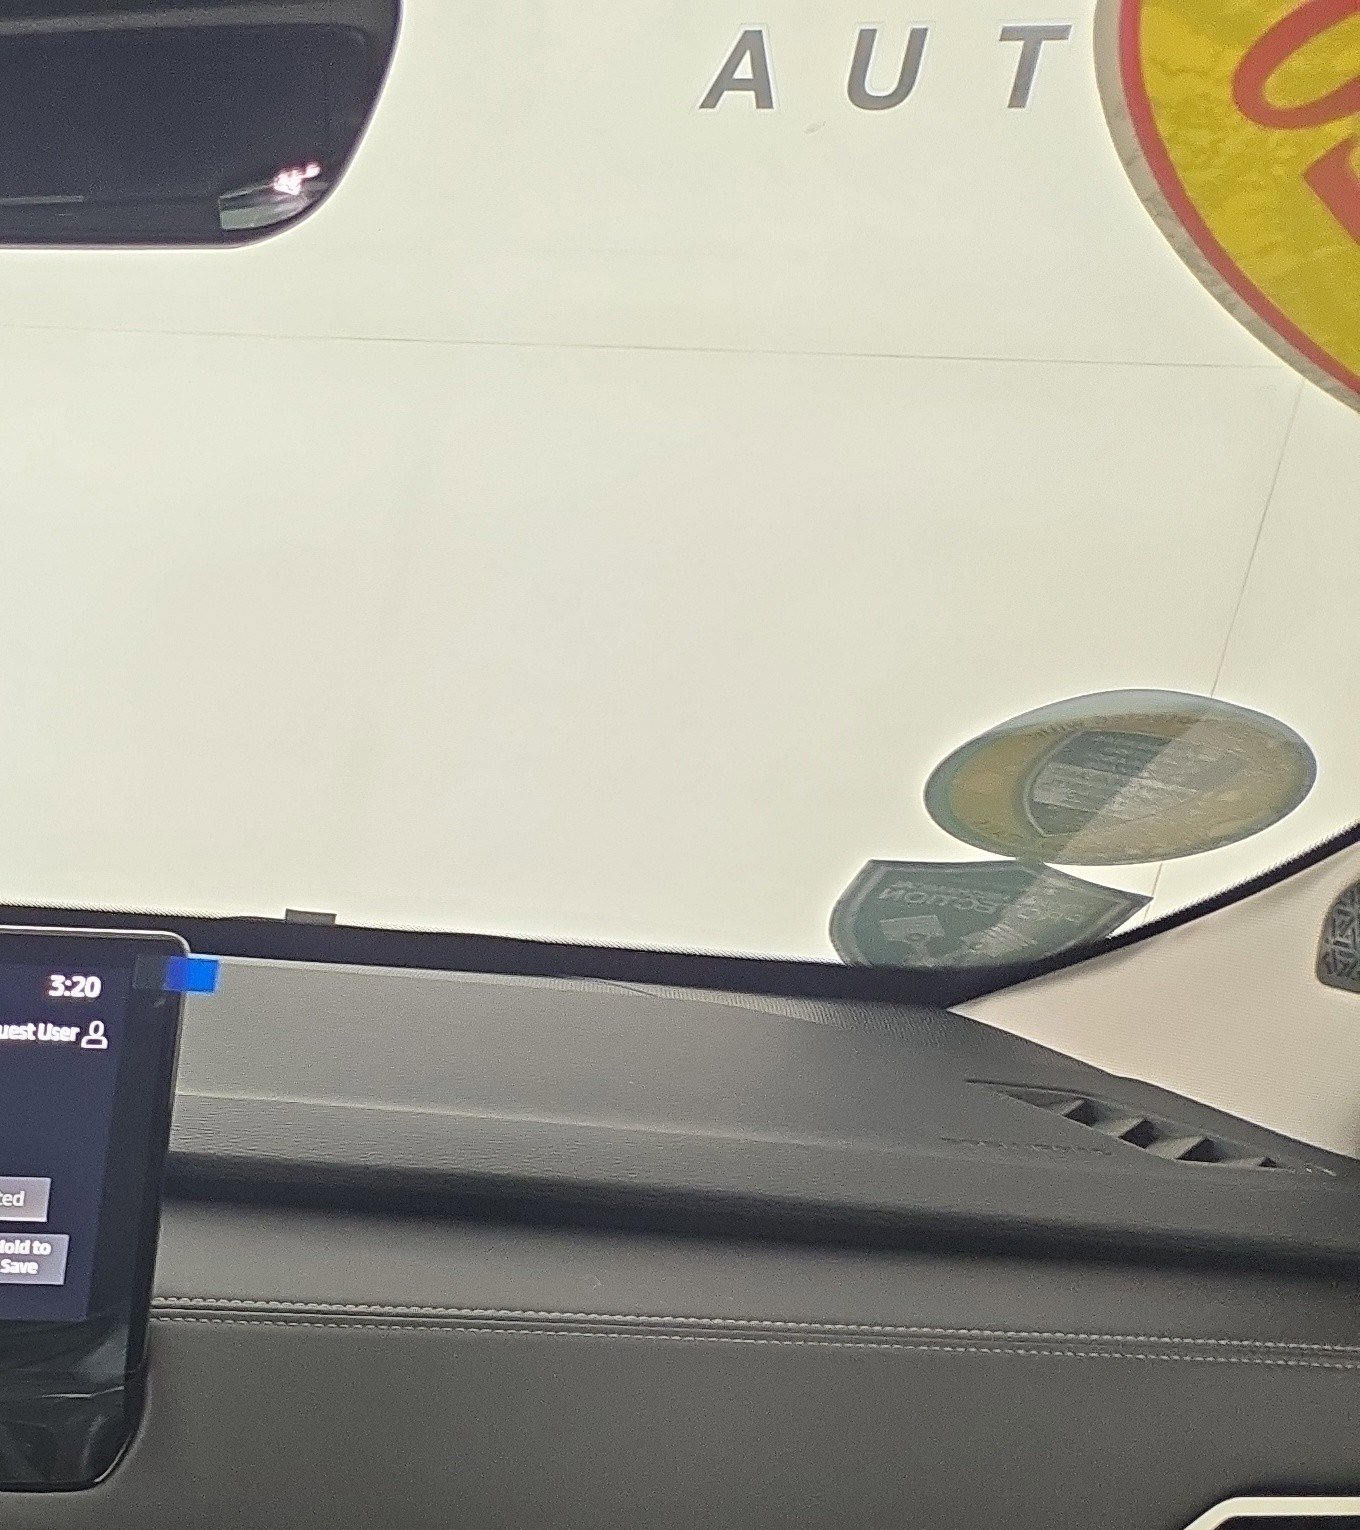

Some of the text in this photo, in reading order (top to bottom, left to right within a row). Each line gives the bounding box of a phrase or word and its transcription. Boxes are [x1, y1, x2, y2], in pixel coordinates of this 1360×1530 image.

[48, 975, 102, 998] 3:20
[38, 1022, 79, 1042] User
[32, 1241, 51, 1256] to
[0, 1259, 39, 1275] Save
